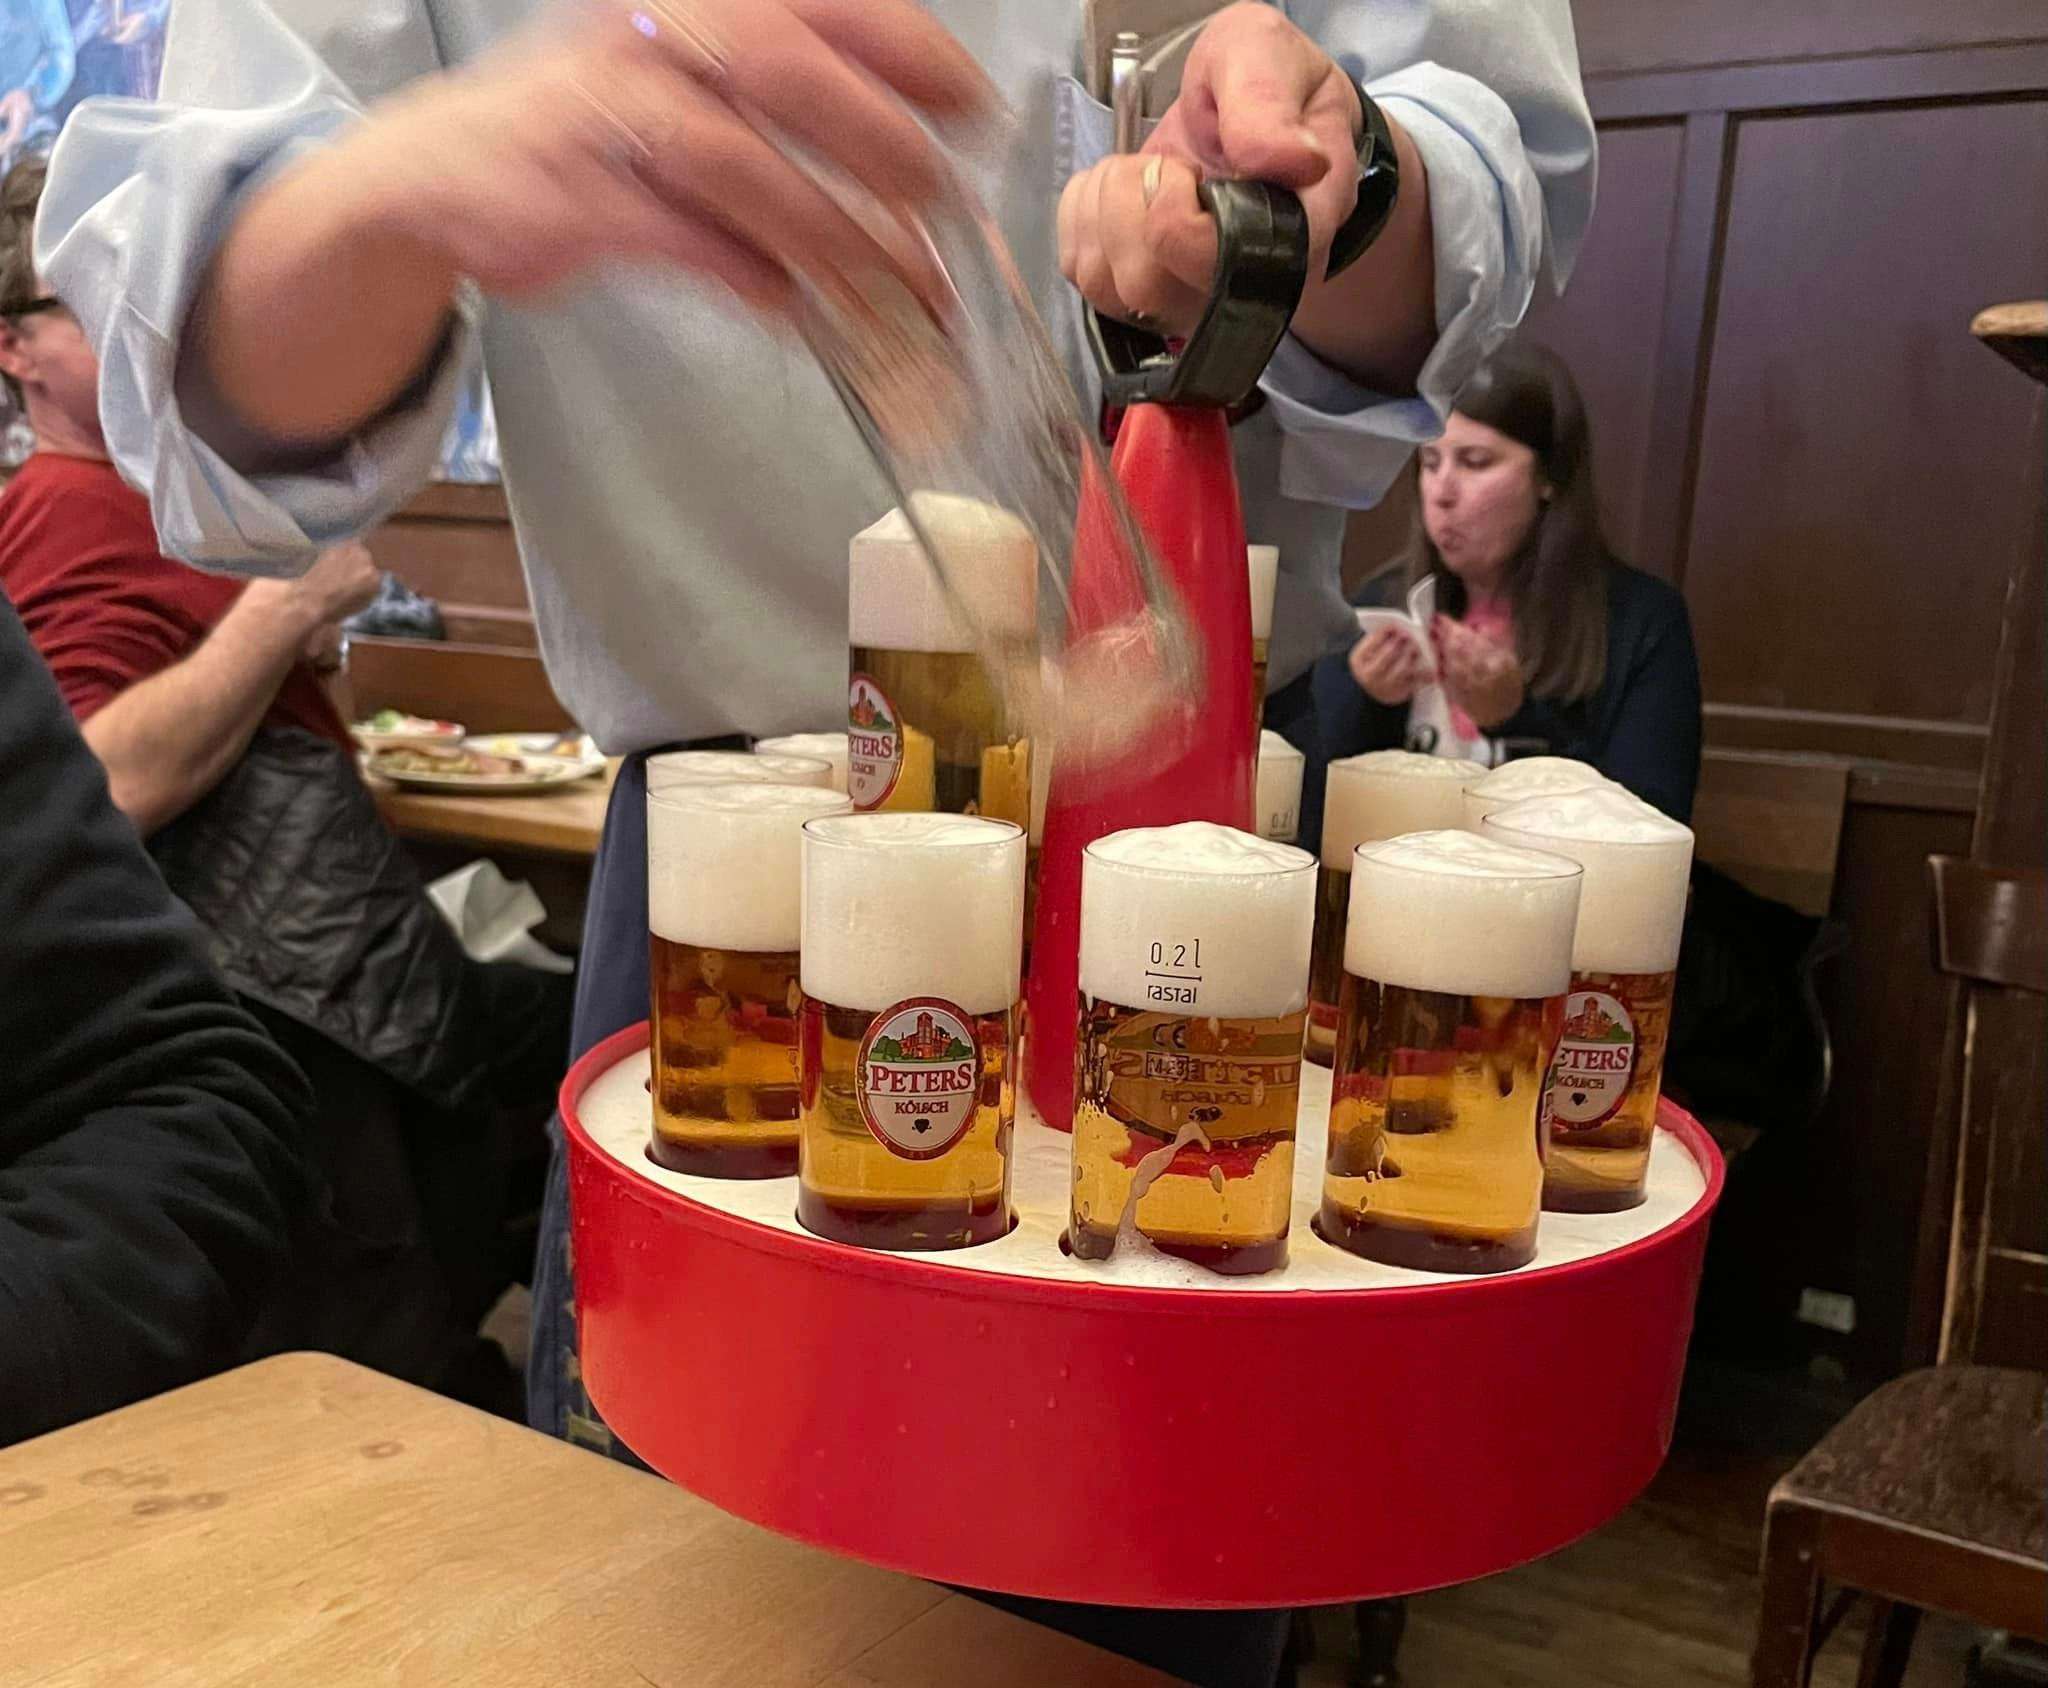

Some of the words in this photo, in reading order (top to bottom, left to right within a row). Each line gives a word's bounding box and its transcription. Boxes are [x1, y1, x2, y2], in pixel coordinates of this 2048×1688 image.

[1147, 985, 1197, 1004] rastal
[870, 1063, 972, 1094] PETERS
[894, 1099, 949, 1115] KÖLSCH
